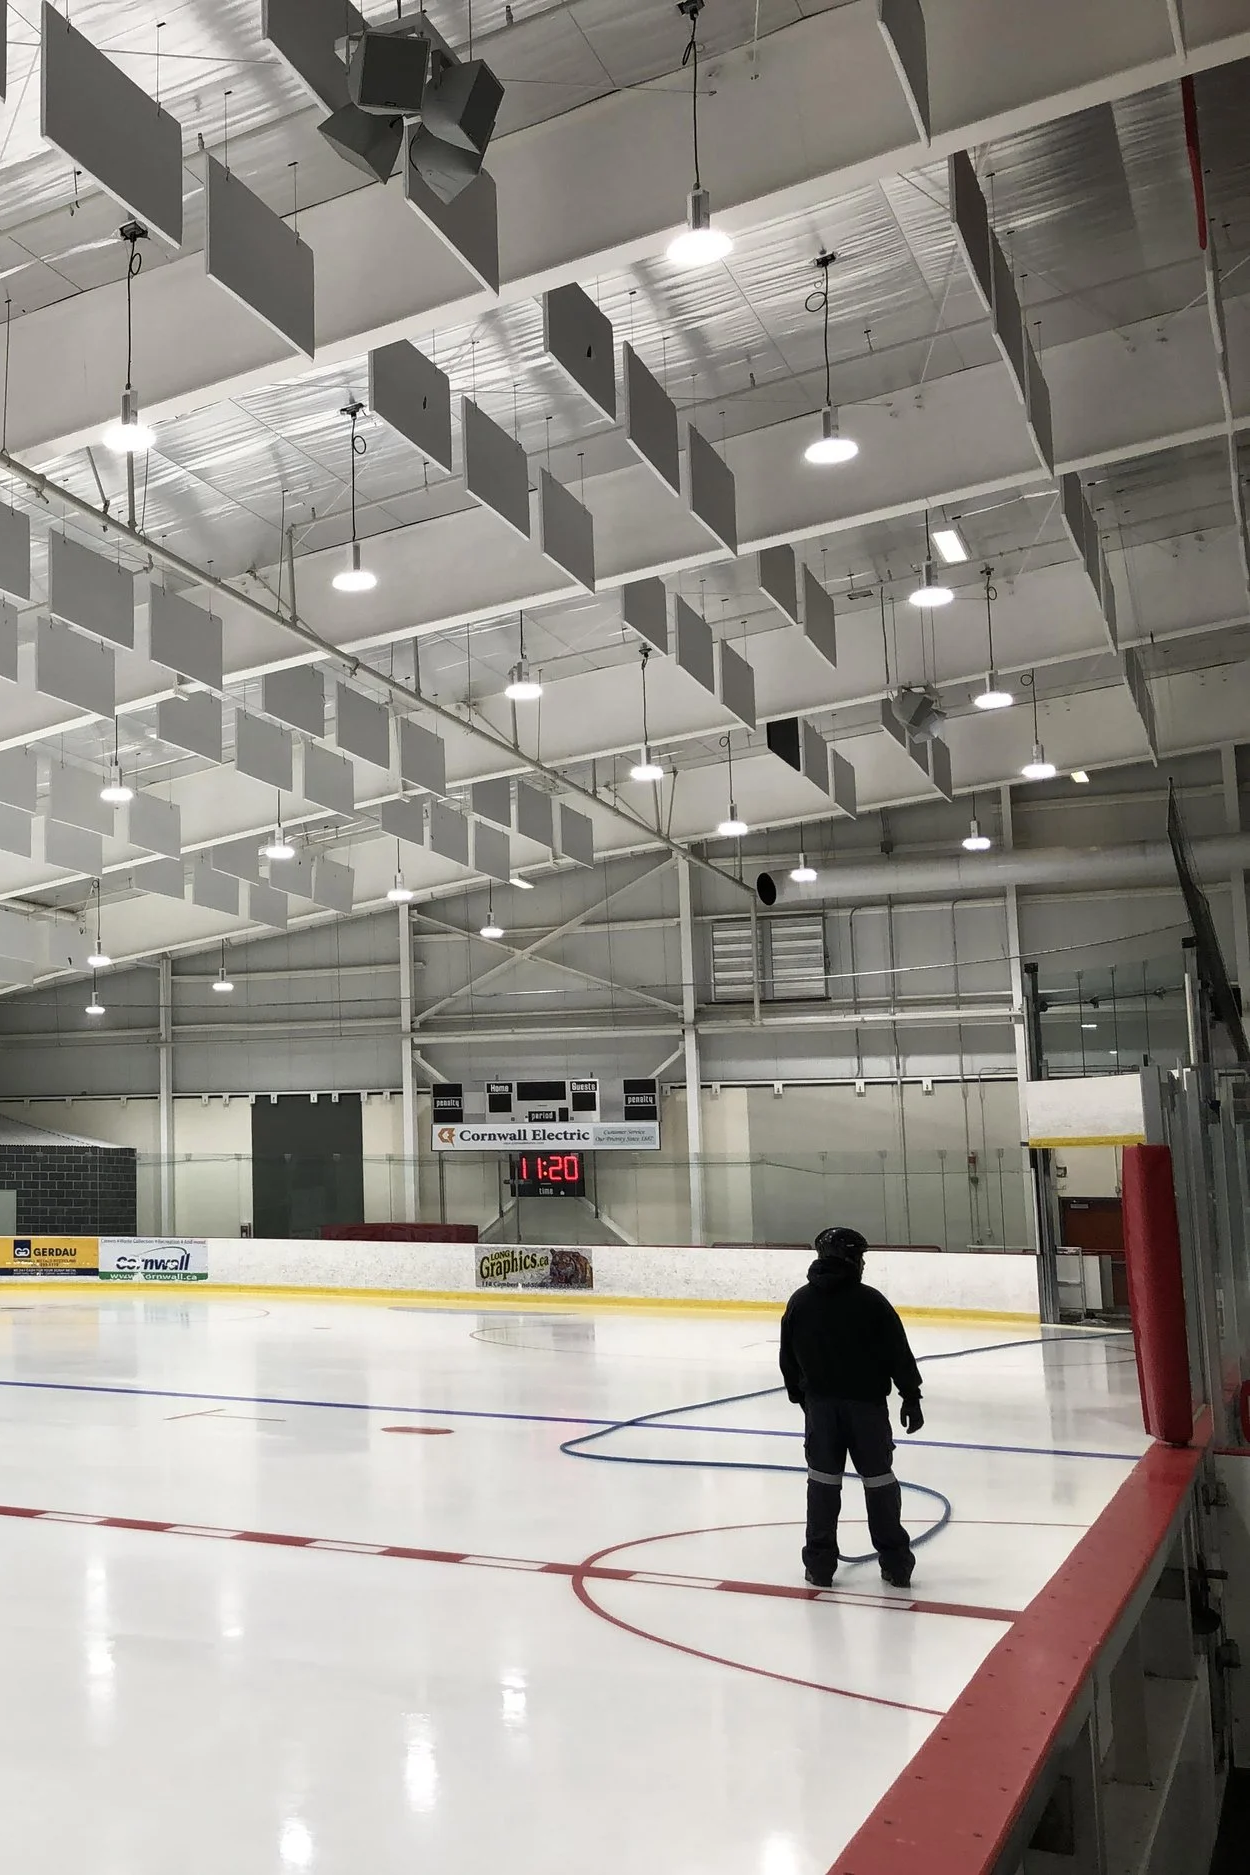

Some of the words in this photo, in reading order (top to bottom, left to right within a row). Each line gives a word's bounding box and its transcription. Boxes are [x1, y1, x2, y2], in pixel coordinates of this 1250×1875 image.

[490, 1084, 509, 1093] Home
[571, 1082, 596, 1091] Guests
[436, 1098, 460, 1108] penalty
[627, 1095, 653, 1105] penalty
[531, 1111, 553, 1120] period
[459, 1129, 527, 1141] Cornwall
[531, 1129, 590, 1141] Electric
[521, 1156, 579, 1180] 11:20
[538, 1187, 554, 1196] time
[34, 1248, 77, 1257] GERDAU
[491, 1250, 510, 1260] LONG
[479, 1250, 549, 1280] Graphics.ca
